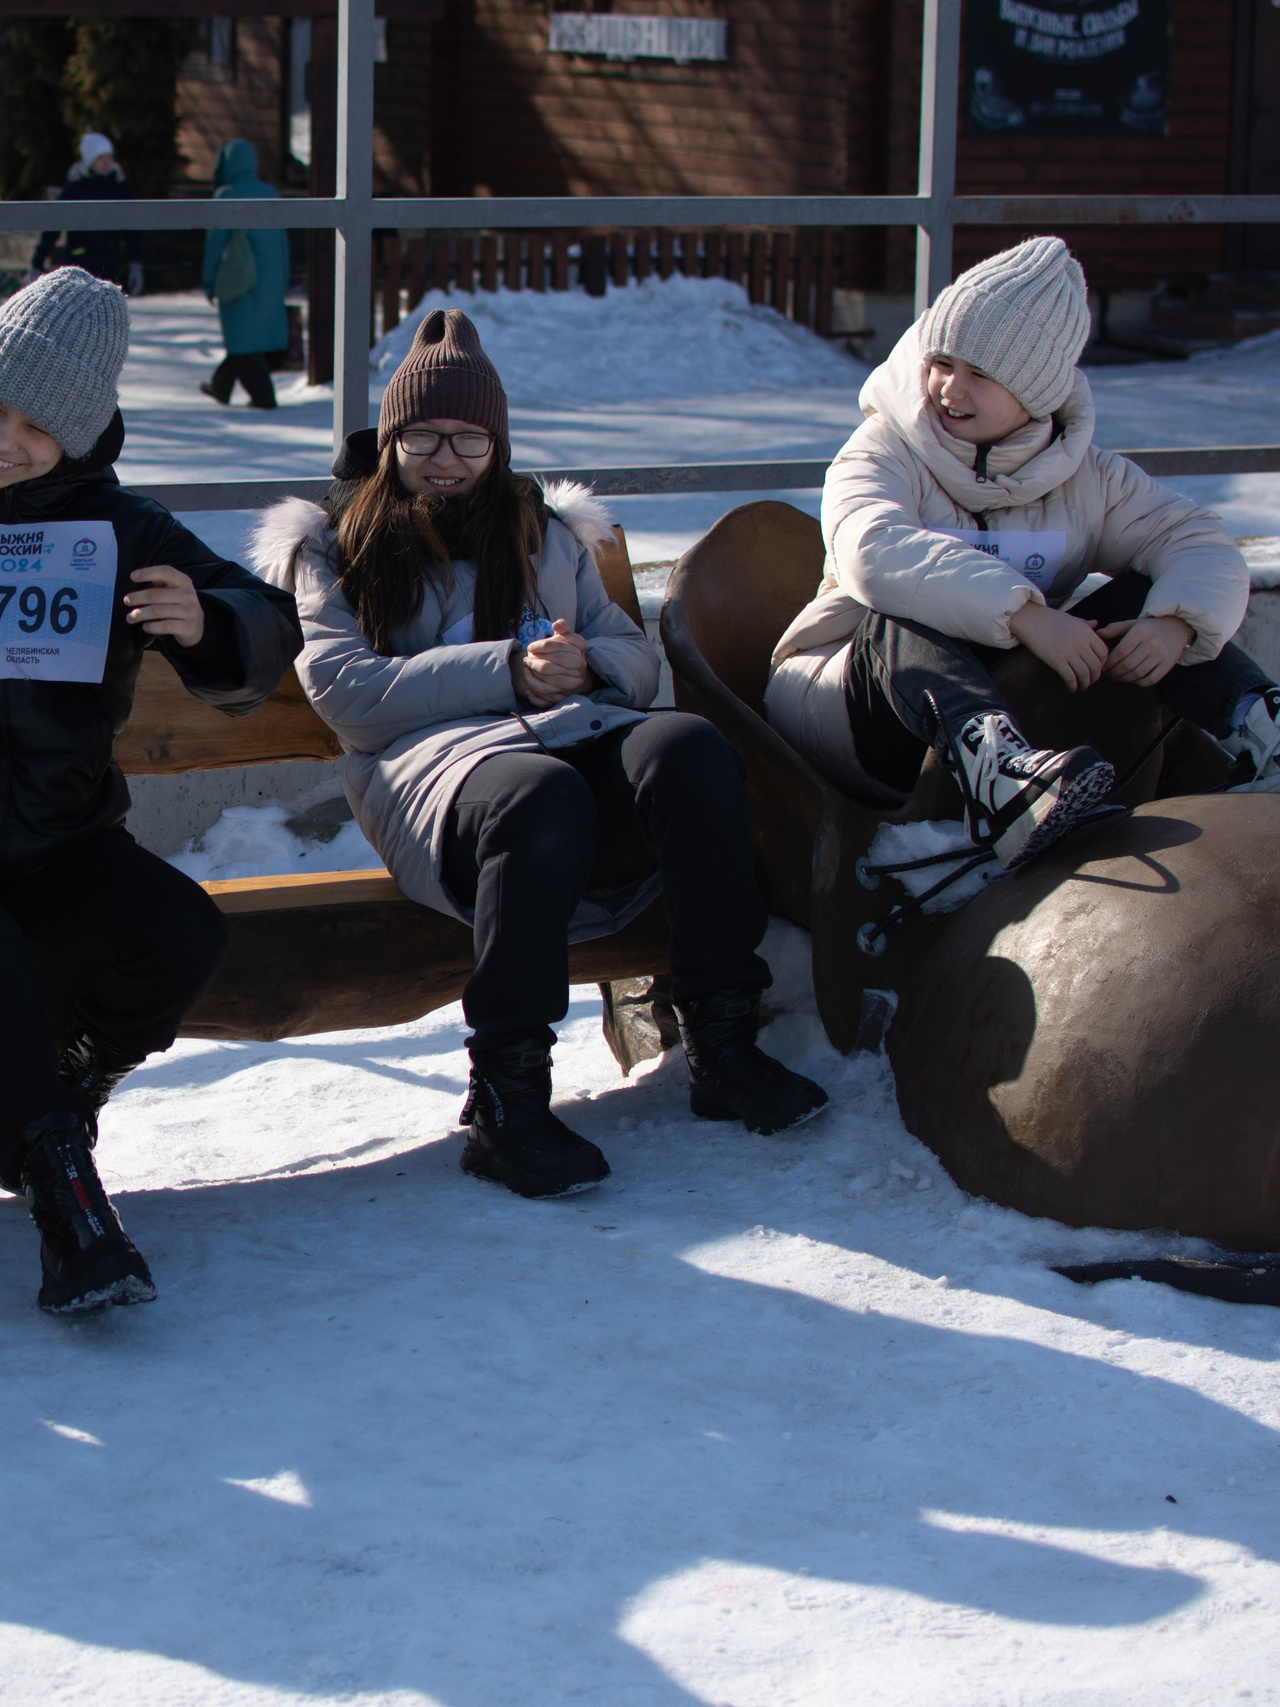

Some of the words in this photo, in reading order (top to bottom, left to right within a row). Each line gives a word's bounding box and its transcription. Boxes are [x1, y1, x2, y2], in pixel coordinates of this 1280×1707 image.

[518, 621, 550, 644] 202
[6, 647, 60, 656] ЧЕЛЯБИНСКАЯ
[6, 655, 40, 664] ОБЛАСТЬ
